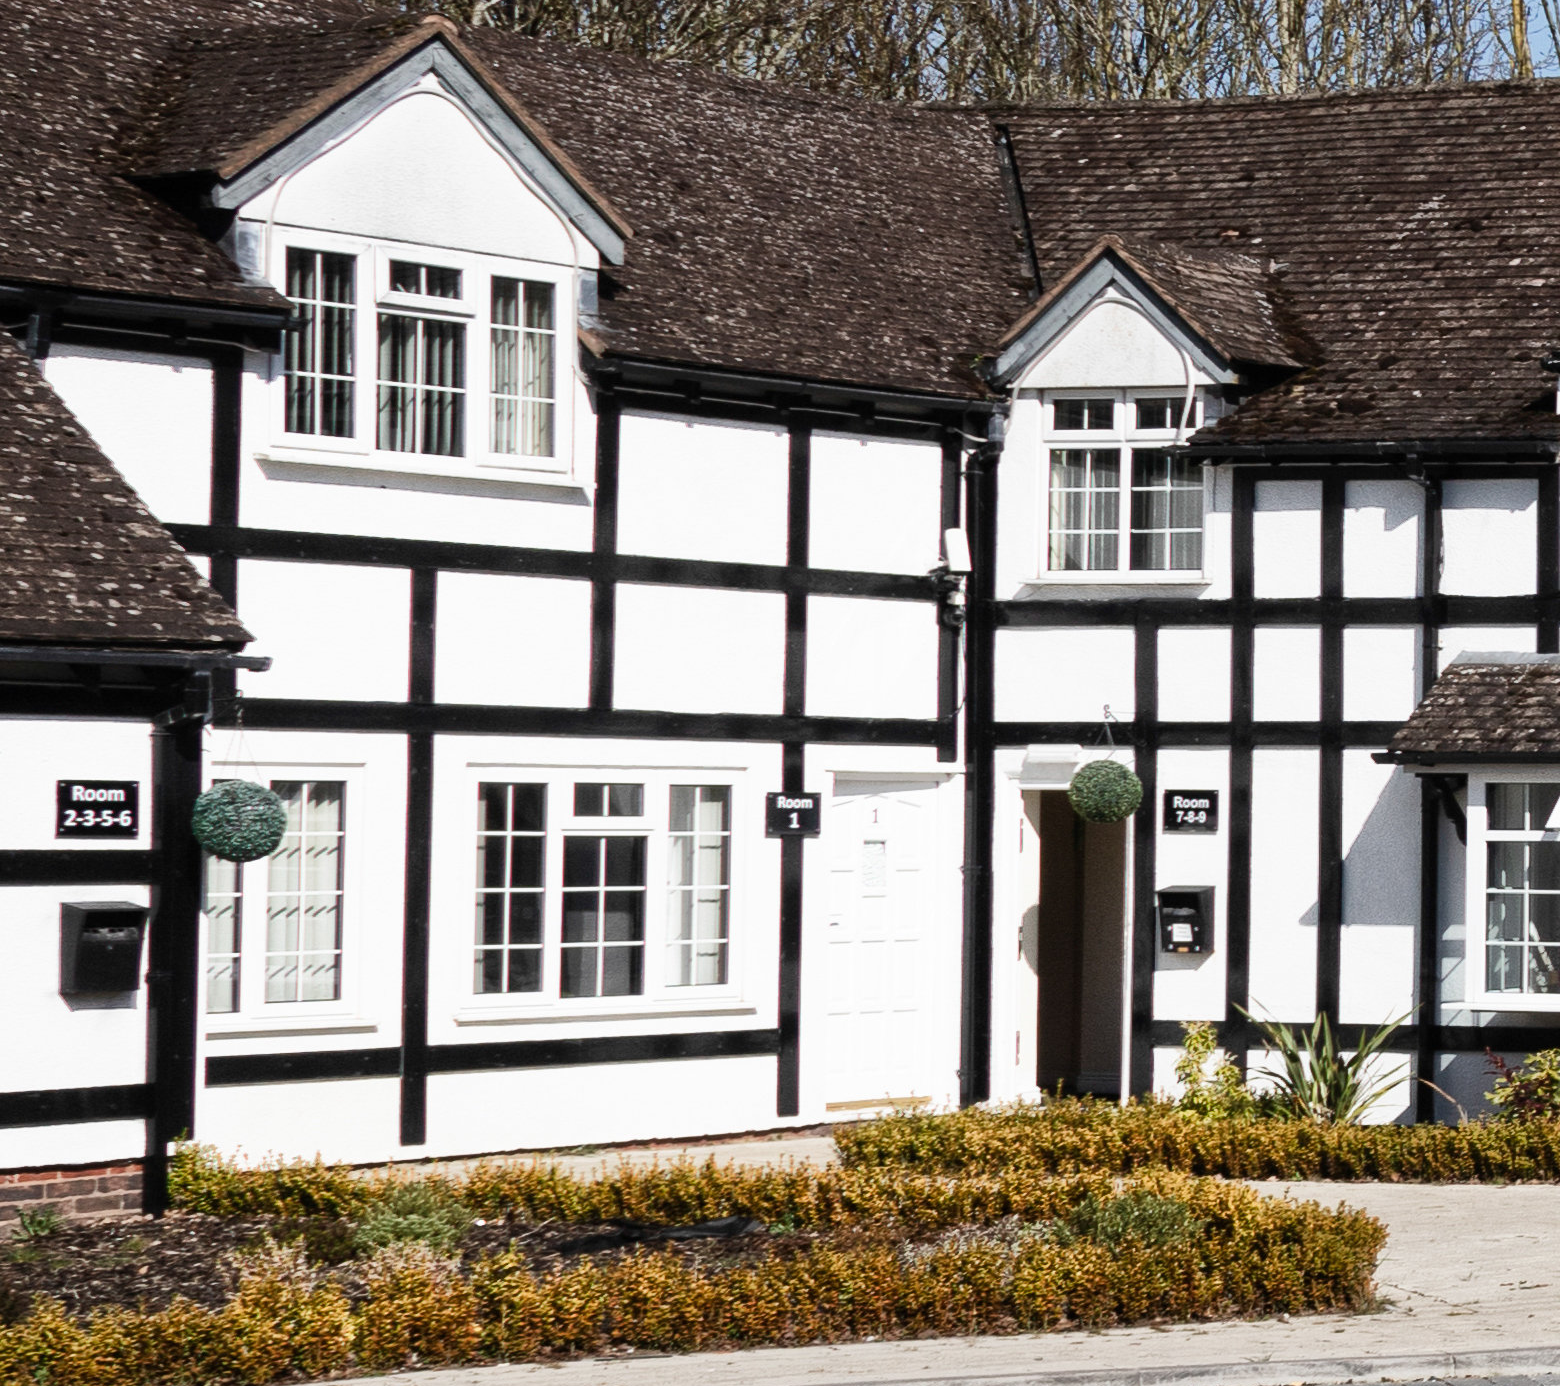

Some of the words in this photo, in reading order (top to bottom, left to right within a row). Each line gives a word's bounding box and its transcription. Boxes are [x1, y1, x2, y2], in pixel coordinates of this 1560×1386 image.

[71, 785, 126, 802] Room
[776, 795, 813, 809] Room
[1172, 795, 1210, 809] Room
[63, 809, 133, 827] 2-3-5-6
[788, 812, 800, 829] 1
[872, 808, 879, 824] 1
[1175, 810, 1207, 824] 7-8-9
